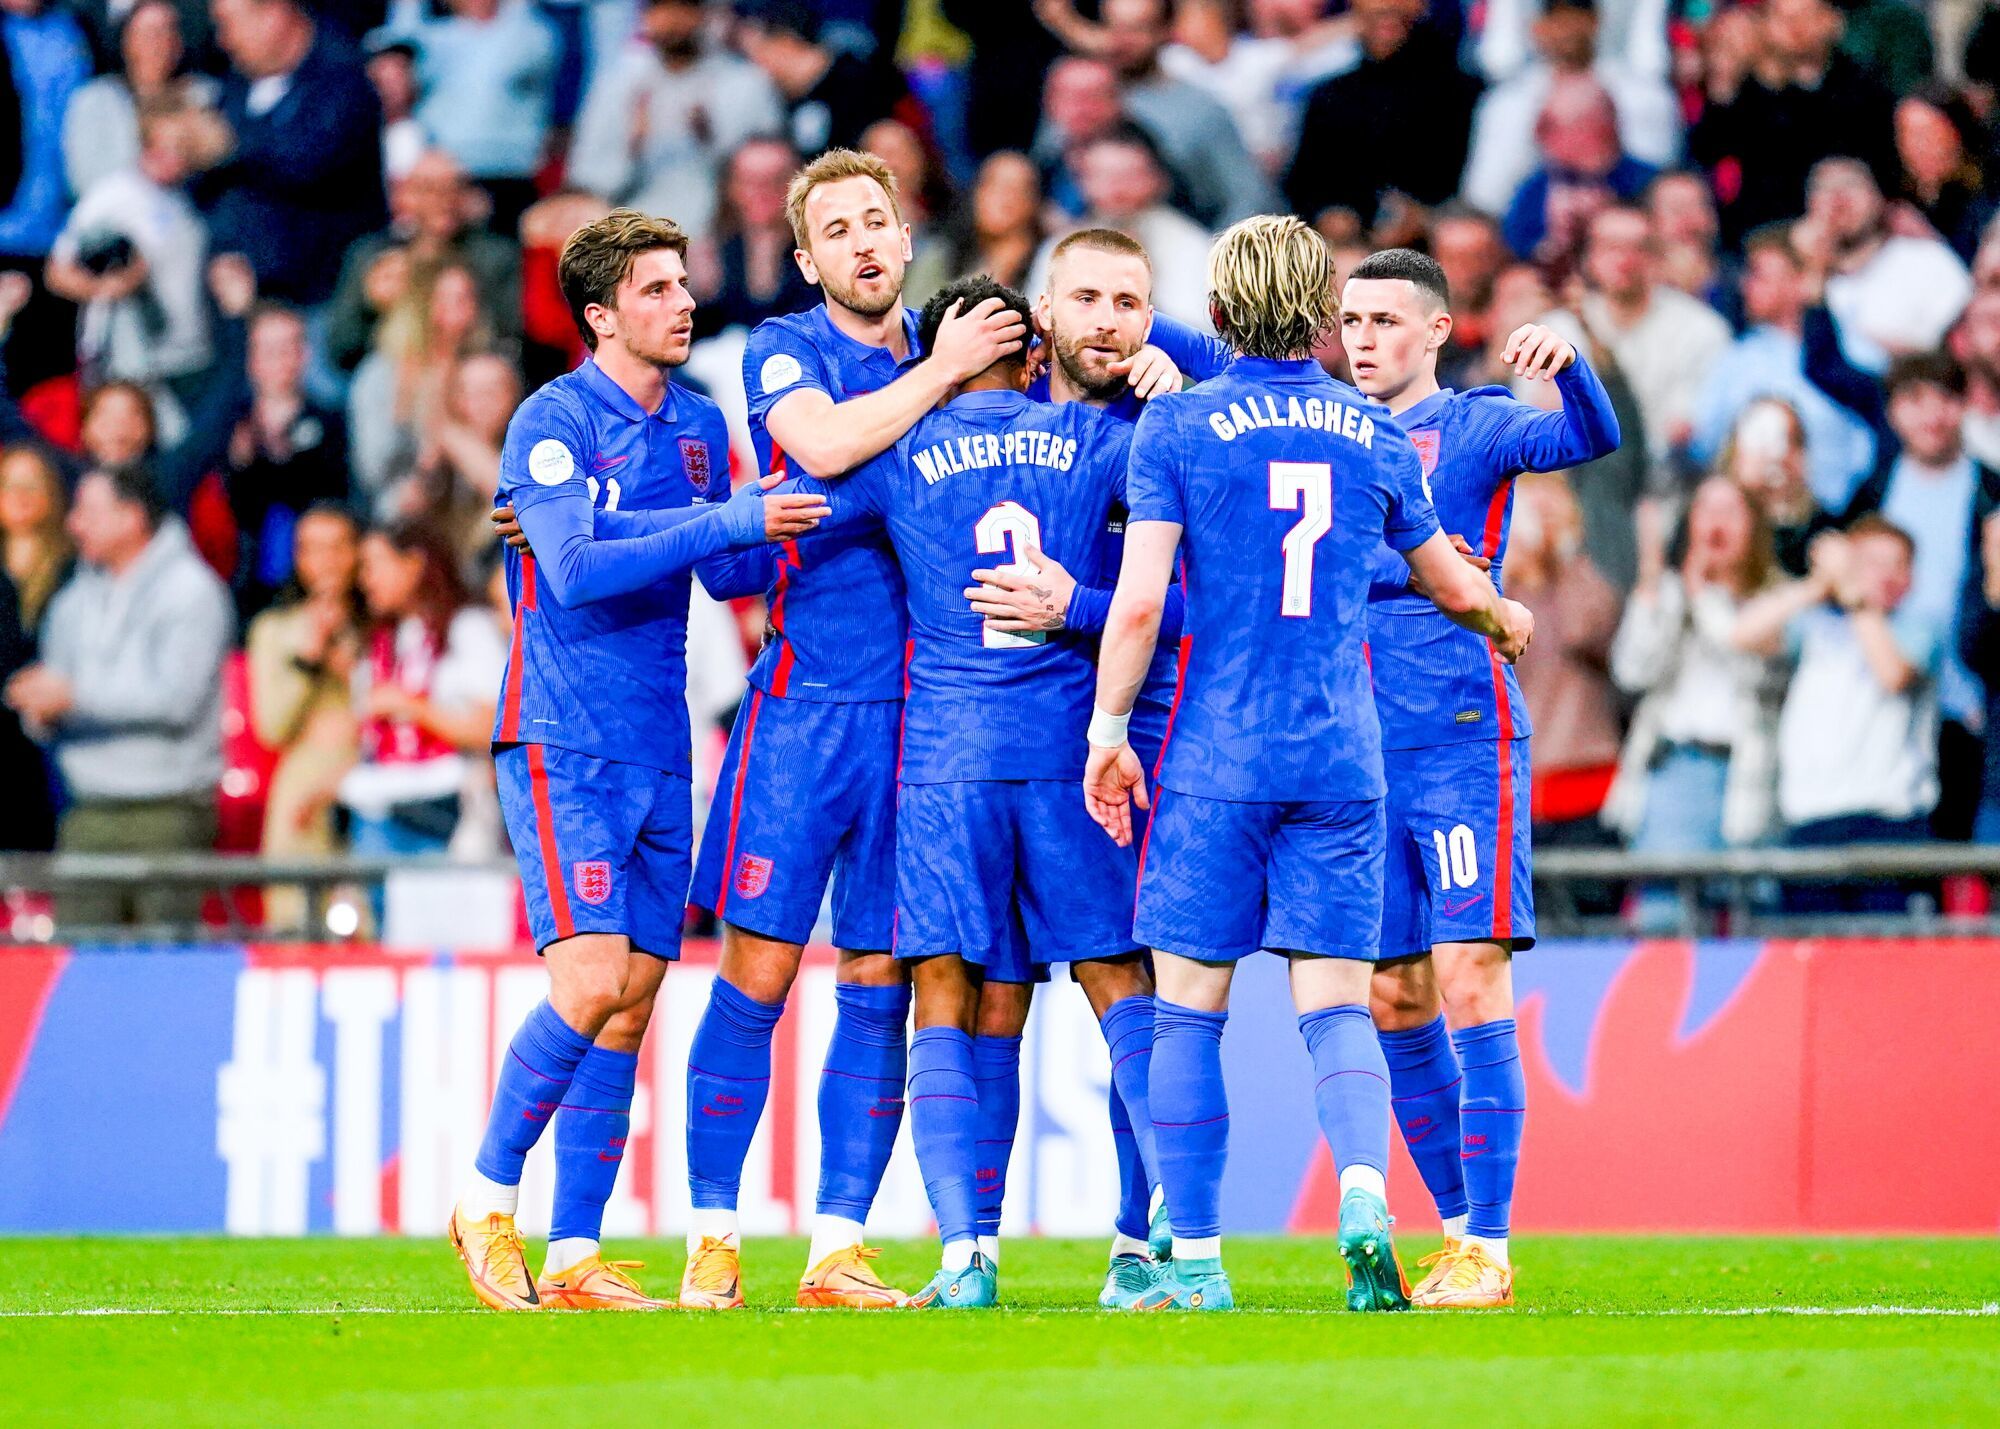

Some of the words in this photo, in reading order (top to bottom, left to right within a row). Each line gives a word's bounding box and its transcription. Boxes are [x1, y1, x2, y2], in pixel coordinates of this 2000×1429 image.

[1208, 395, 1376, 450] GALLAGHER
[911, 430, 1077, 486] WALKER-PETERS
[1268, 460, 1333, 618] 7
[1433, 823, 1479, 891] 10
